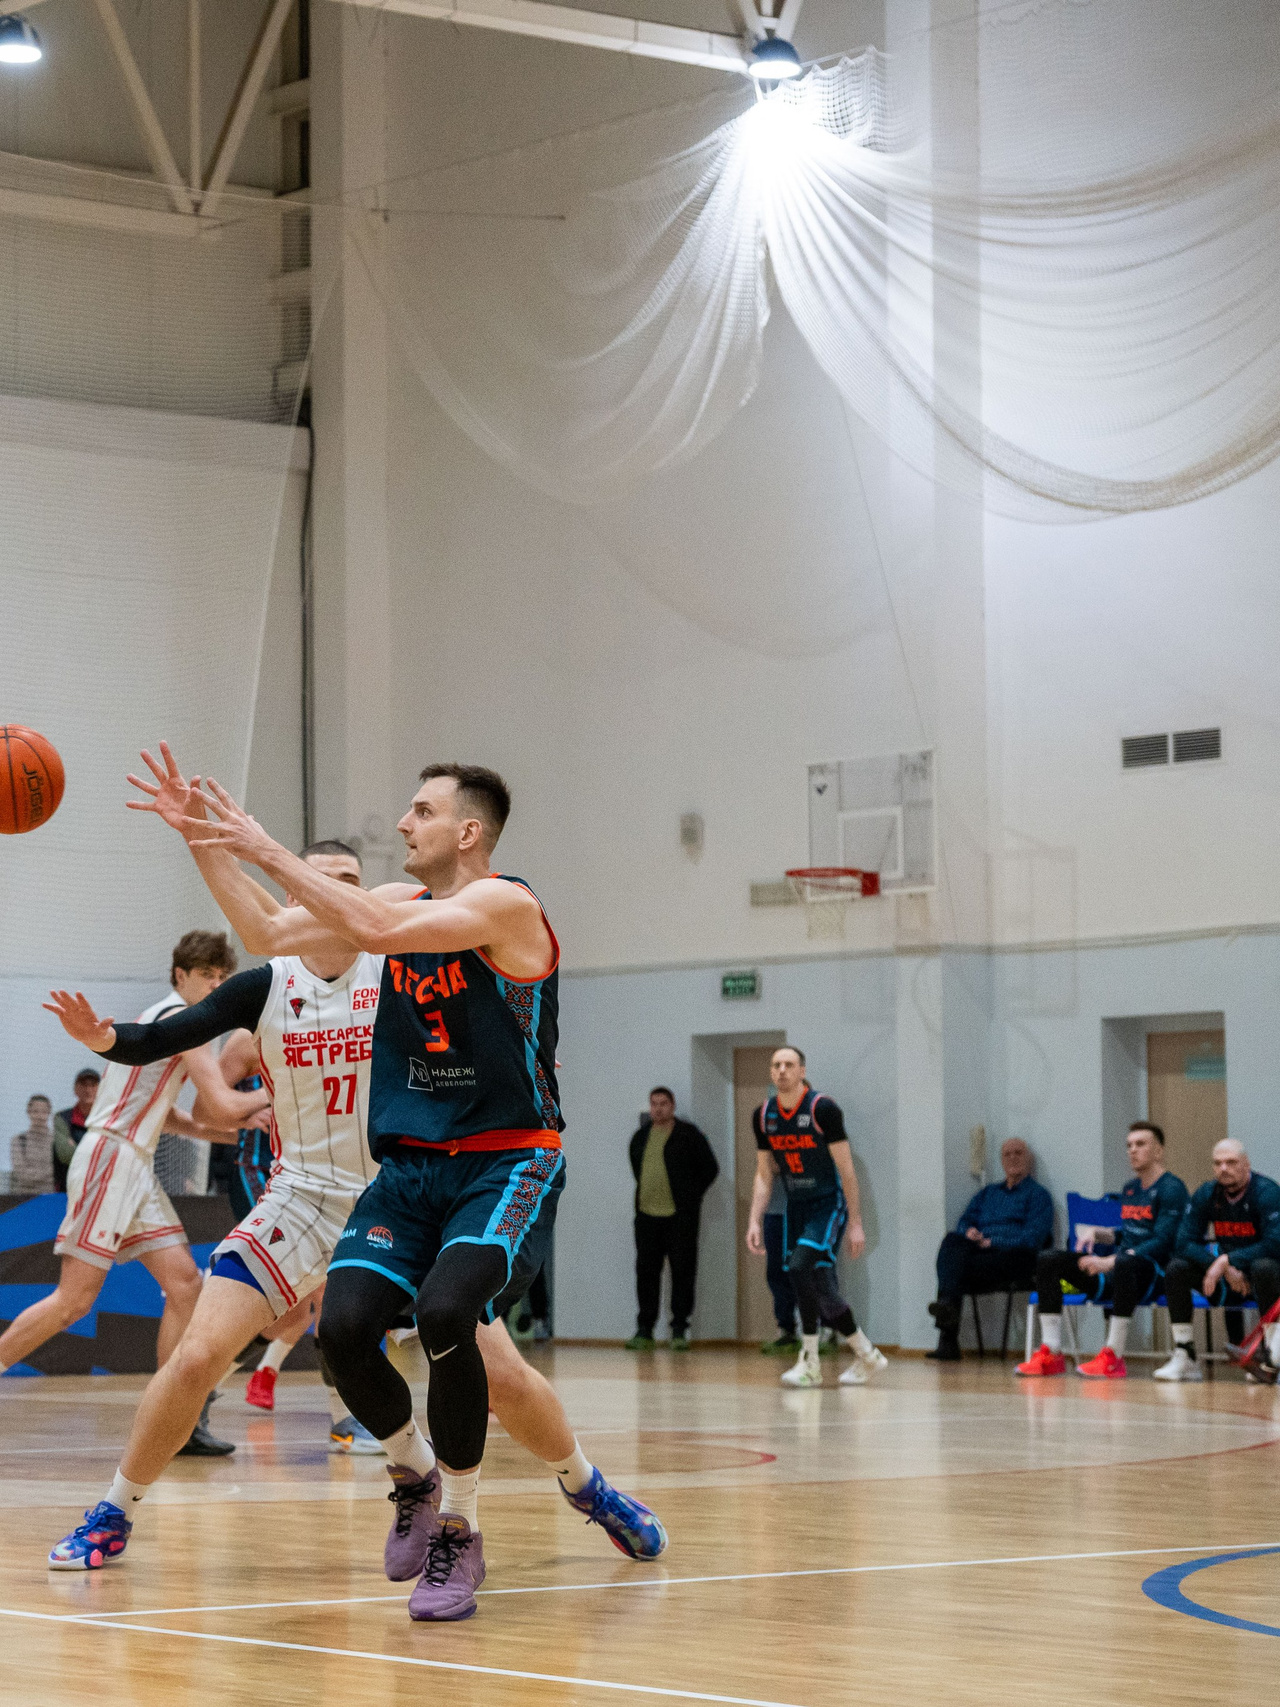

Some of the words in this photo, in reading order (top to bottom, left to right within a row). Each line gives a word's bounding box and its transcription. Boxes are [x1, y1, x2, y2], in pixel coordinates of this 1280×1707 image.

[352, 998, 379, 1010] BET
[353, 988, 379, 1000] FON
[282, 1024, 375, 1046] ЧЕБОКСАРСК
[424, 1010, 450, 1052] 3
[283, 1040, 373, 1068] ЯСТРЕБ
[431, 1067, 475, 1078] НАДЕЖ
[322, 1074, 357, 1116] 27
